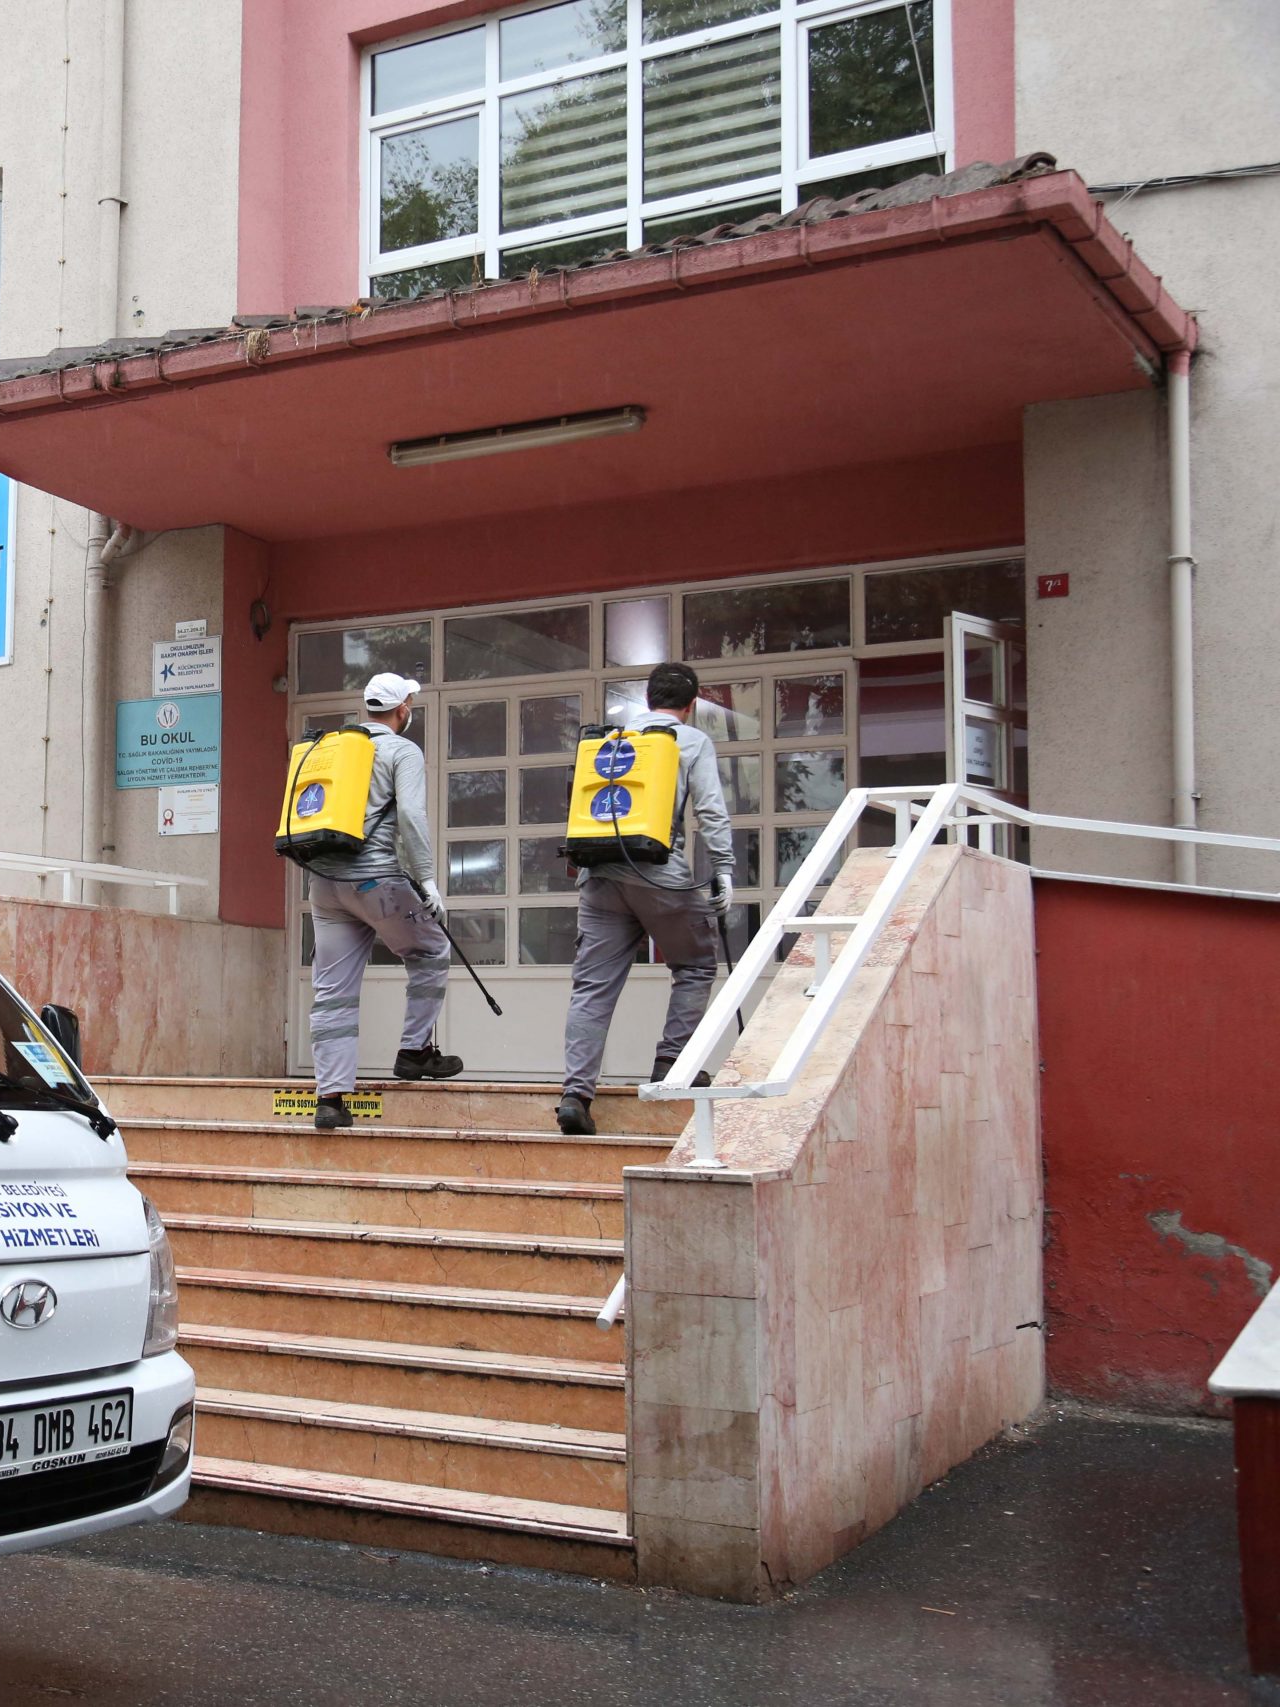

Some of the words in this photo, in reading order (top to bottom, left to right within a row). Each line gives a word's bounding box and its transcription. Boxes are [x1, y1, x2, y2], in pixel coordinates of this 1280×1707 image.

[140, 734, 158, 746] BU
[161, 731, 196, 745] OKUL
[151, 756, 183, 766] COVİD-19
[3, 1180, 69, 1198] BELEDİYESİ
[49, 1202, 78, 1218] VE
[33, 1408, 75, 1456] DMB
[88, 1399, 127, 1444] 462
